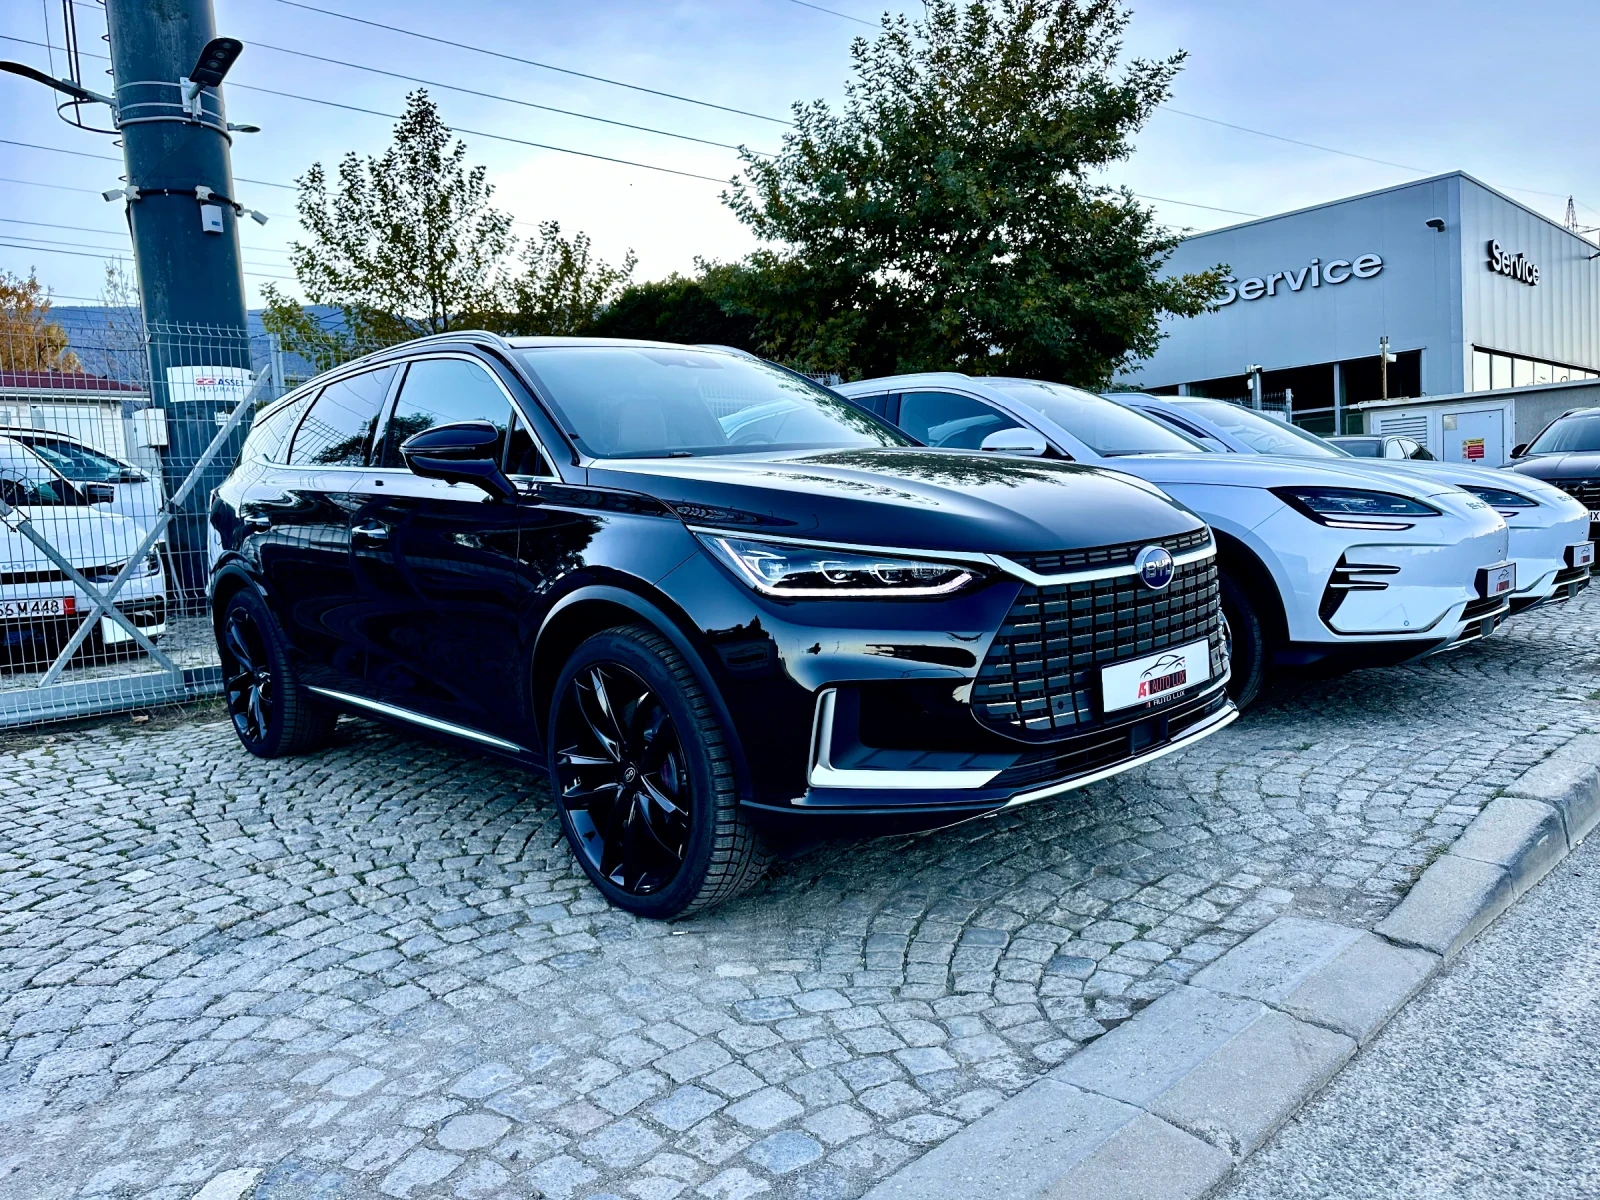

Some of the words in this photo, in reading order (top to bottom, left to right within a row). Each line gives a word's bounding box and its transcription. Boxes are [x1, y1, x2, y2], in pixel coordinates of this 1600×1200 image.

[1491, 238, 1540, 286] Service
[1208, 253, 1383, 307] Service
[218, 378, 244, 387] ASSET
[1146, 559, 1172, 579] BYD
[1138, 681, 1150, 698] A1
[1151, 675, 1171, 693] AUTO
[1172, 670, 1186, 686] LUX
[1153, 693, 1172, 706] AUTO
[1172, 690, 1185, 699] LUX
